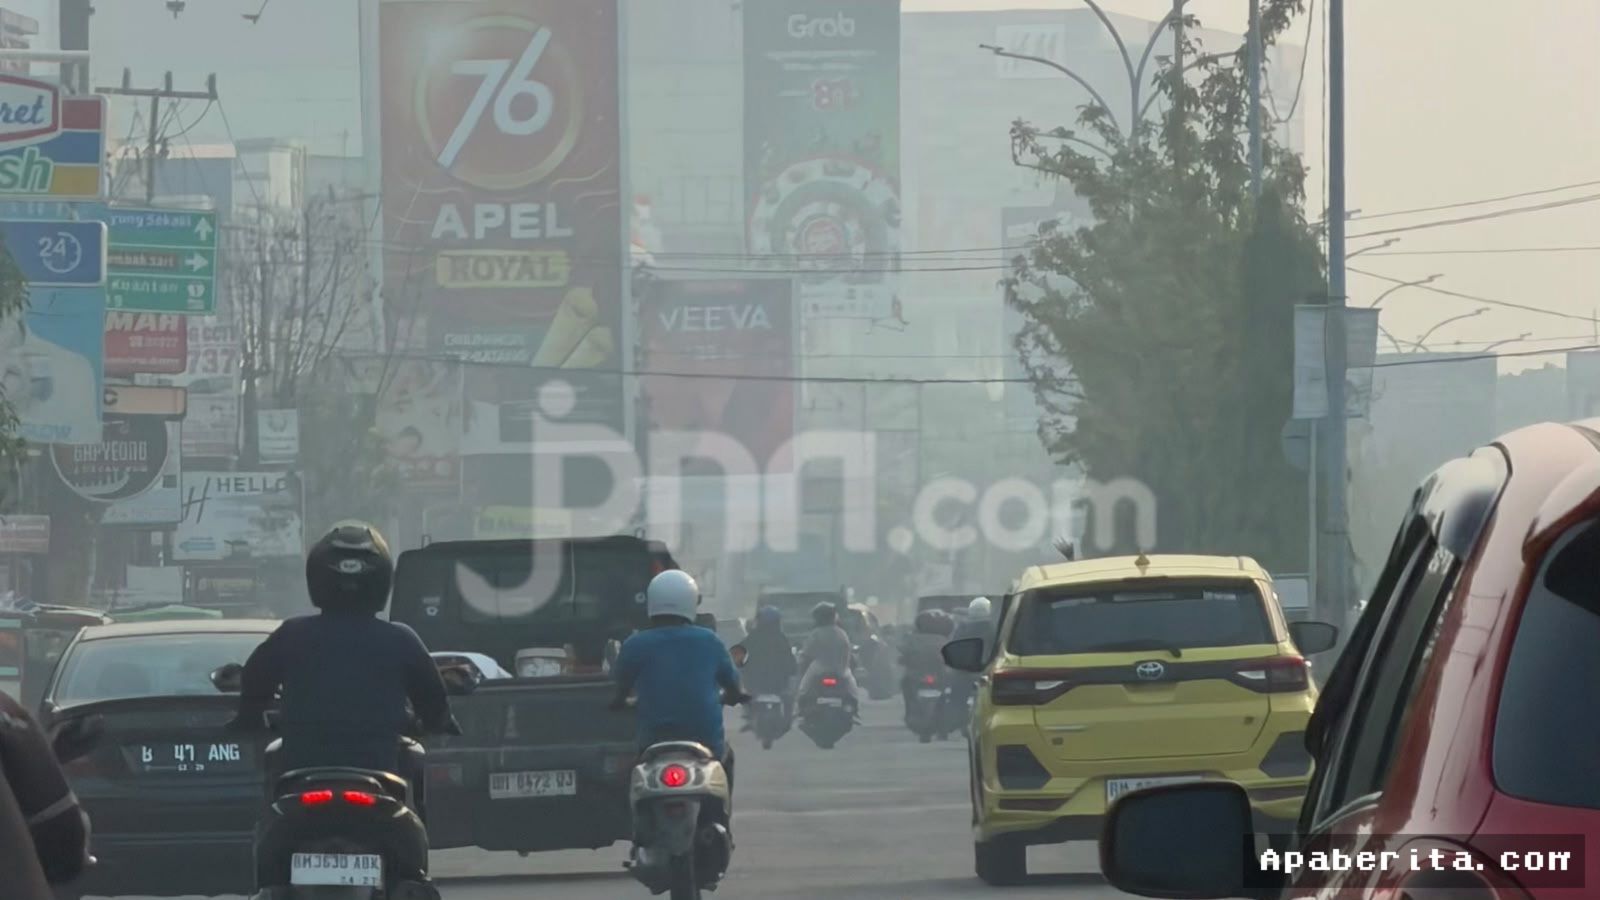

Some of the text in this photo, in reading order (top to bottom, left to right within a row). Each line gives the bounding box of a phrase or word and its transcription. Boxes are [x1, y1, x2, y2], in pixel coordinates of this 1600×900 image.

[787, 9, 856, 39] Grab
[436, 25, 554, 171] 76
[431, 202, 573, 240] APEL
[38, 236, 67, 258] 24
[447, 255, 560, 281] ROYAL
[658, 303, 773, 332] VEEVA
[216, 477, 288, 493] HELLO
[208, 743, 241, 761] ANG
